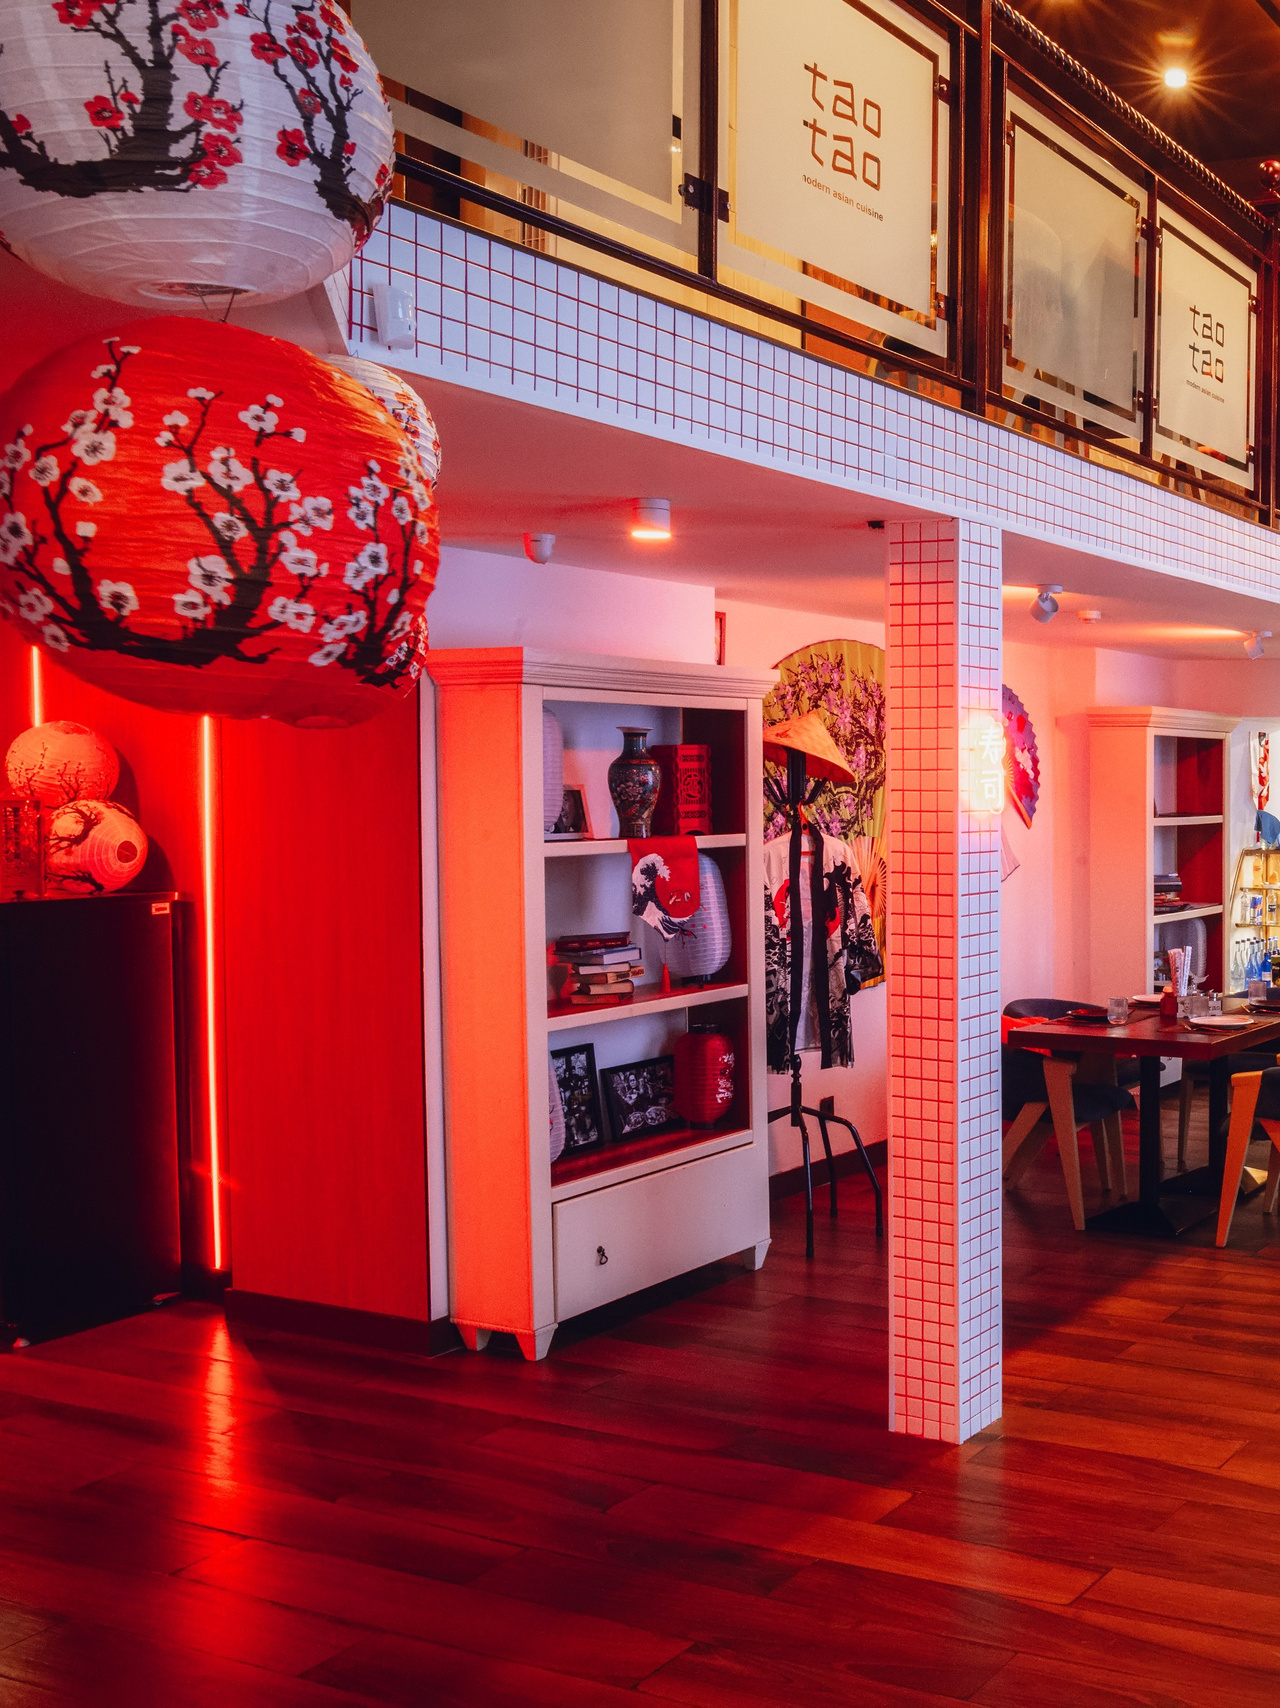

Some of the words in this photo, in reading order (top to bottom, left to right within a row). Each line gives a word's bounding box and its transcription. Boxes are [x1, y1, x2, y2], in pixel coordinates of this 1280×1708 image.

[804, 62, 881, 139] tao
[803, 118, 881, 191] tao
[833, 190, 854, 207] asian
[856, 202, 884, 222] cuisine
[1189, 305, 1224, 348] tao
[1188, 342, 1224, 383] tao
